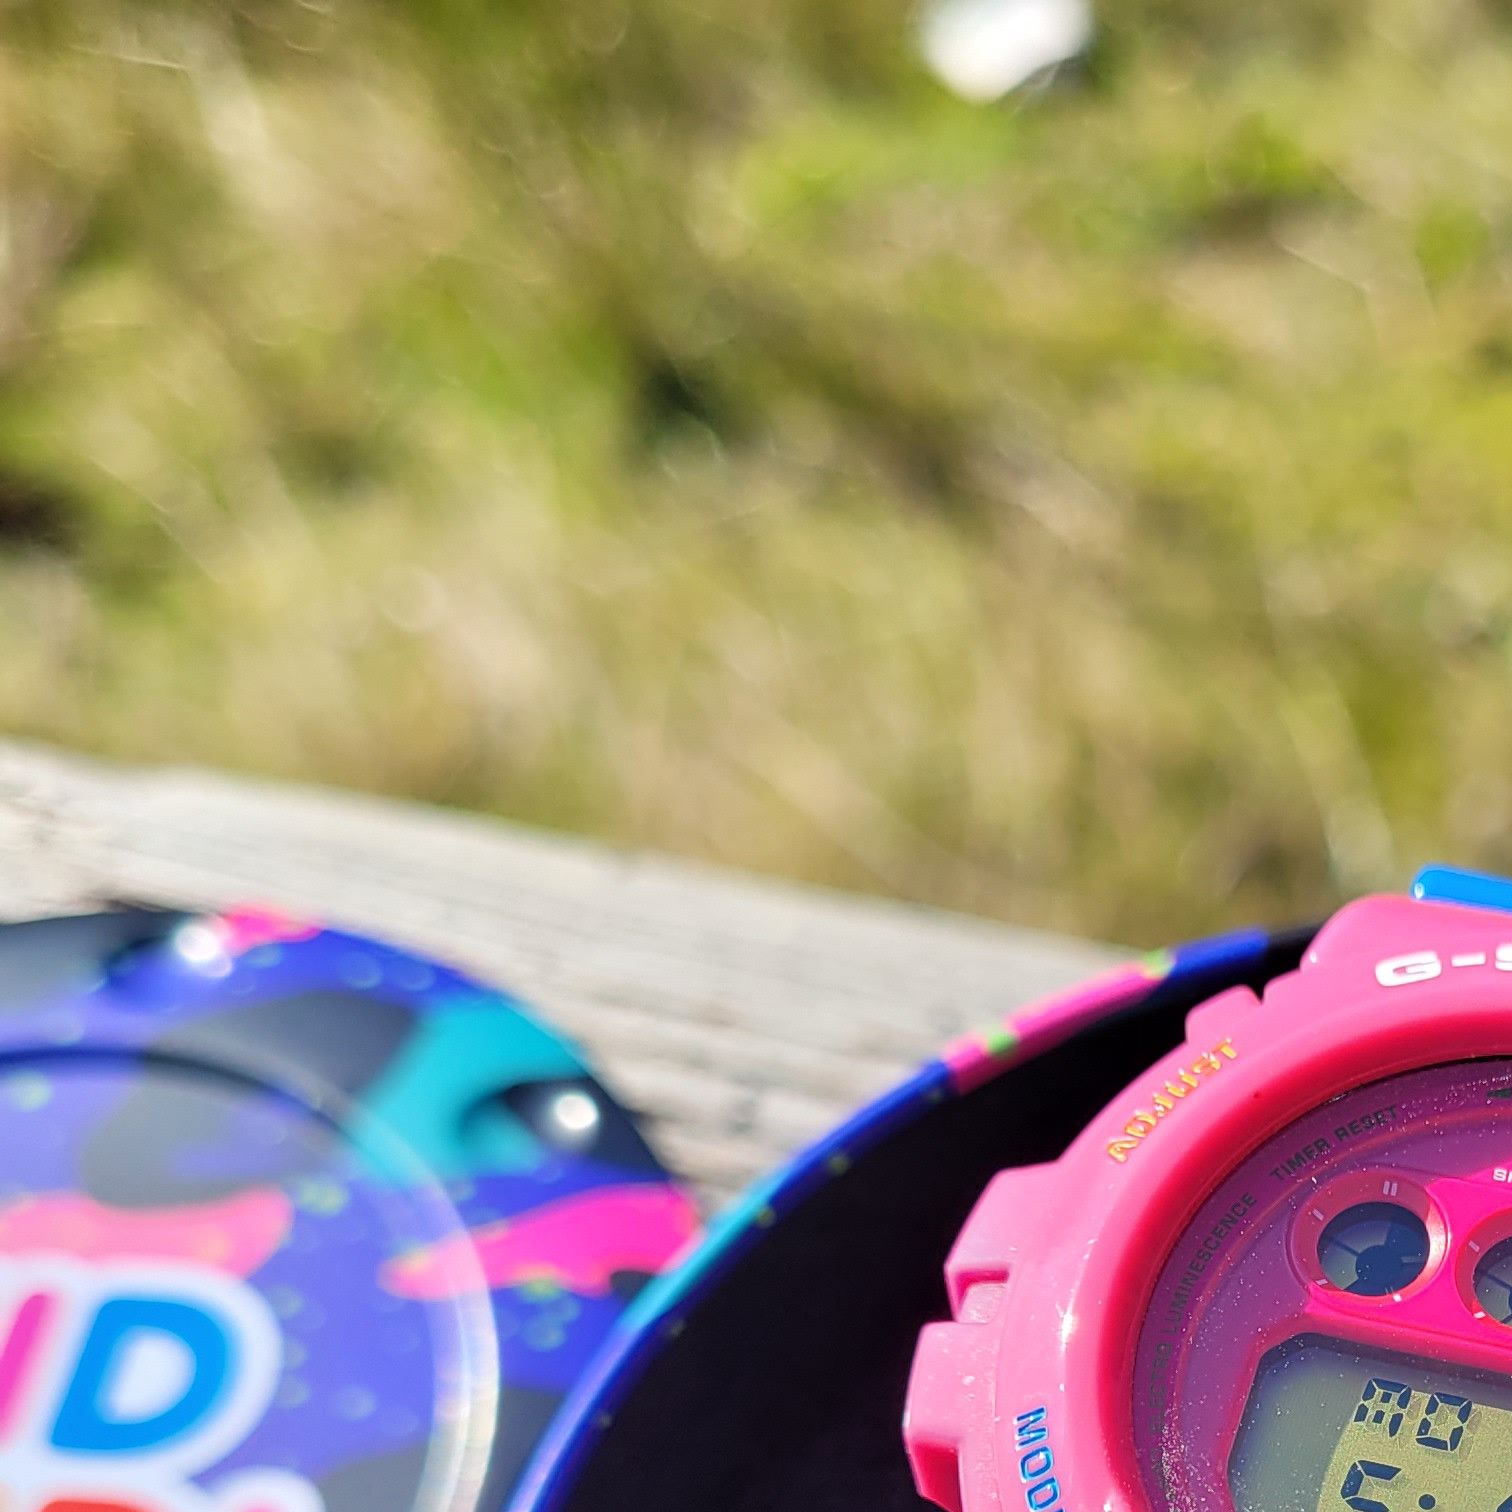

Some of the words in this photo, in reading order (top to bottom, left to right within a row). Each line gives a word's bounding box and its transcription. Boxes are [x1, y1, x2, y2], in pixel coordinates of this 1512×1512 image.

[1107, 1036, 1238, 1164] ADJUST
[1268, 1136, 1332, 1182] TIMER
[1333, 1104, 1398, 1143] RESET
[1162, 1193, 1259, 1335] LUMINESCENCE
[0, 1292, 230, 1453] ID
[1353, 1377, 1473, 1452] MO
